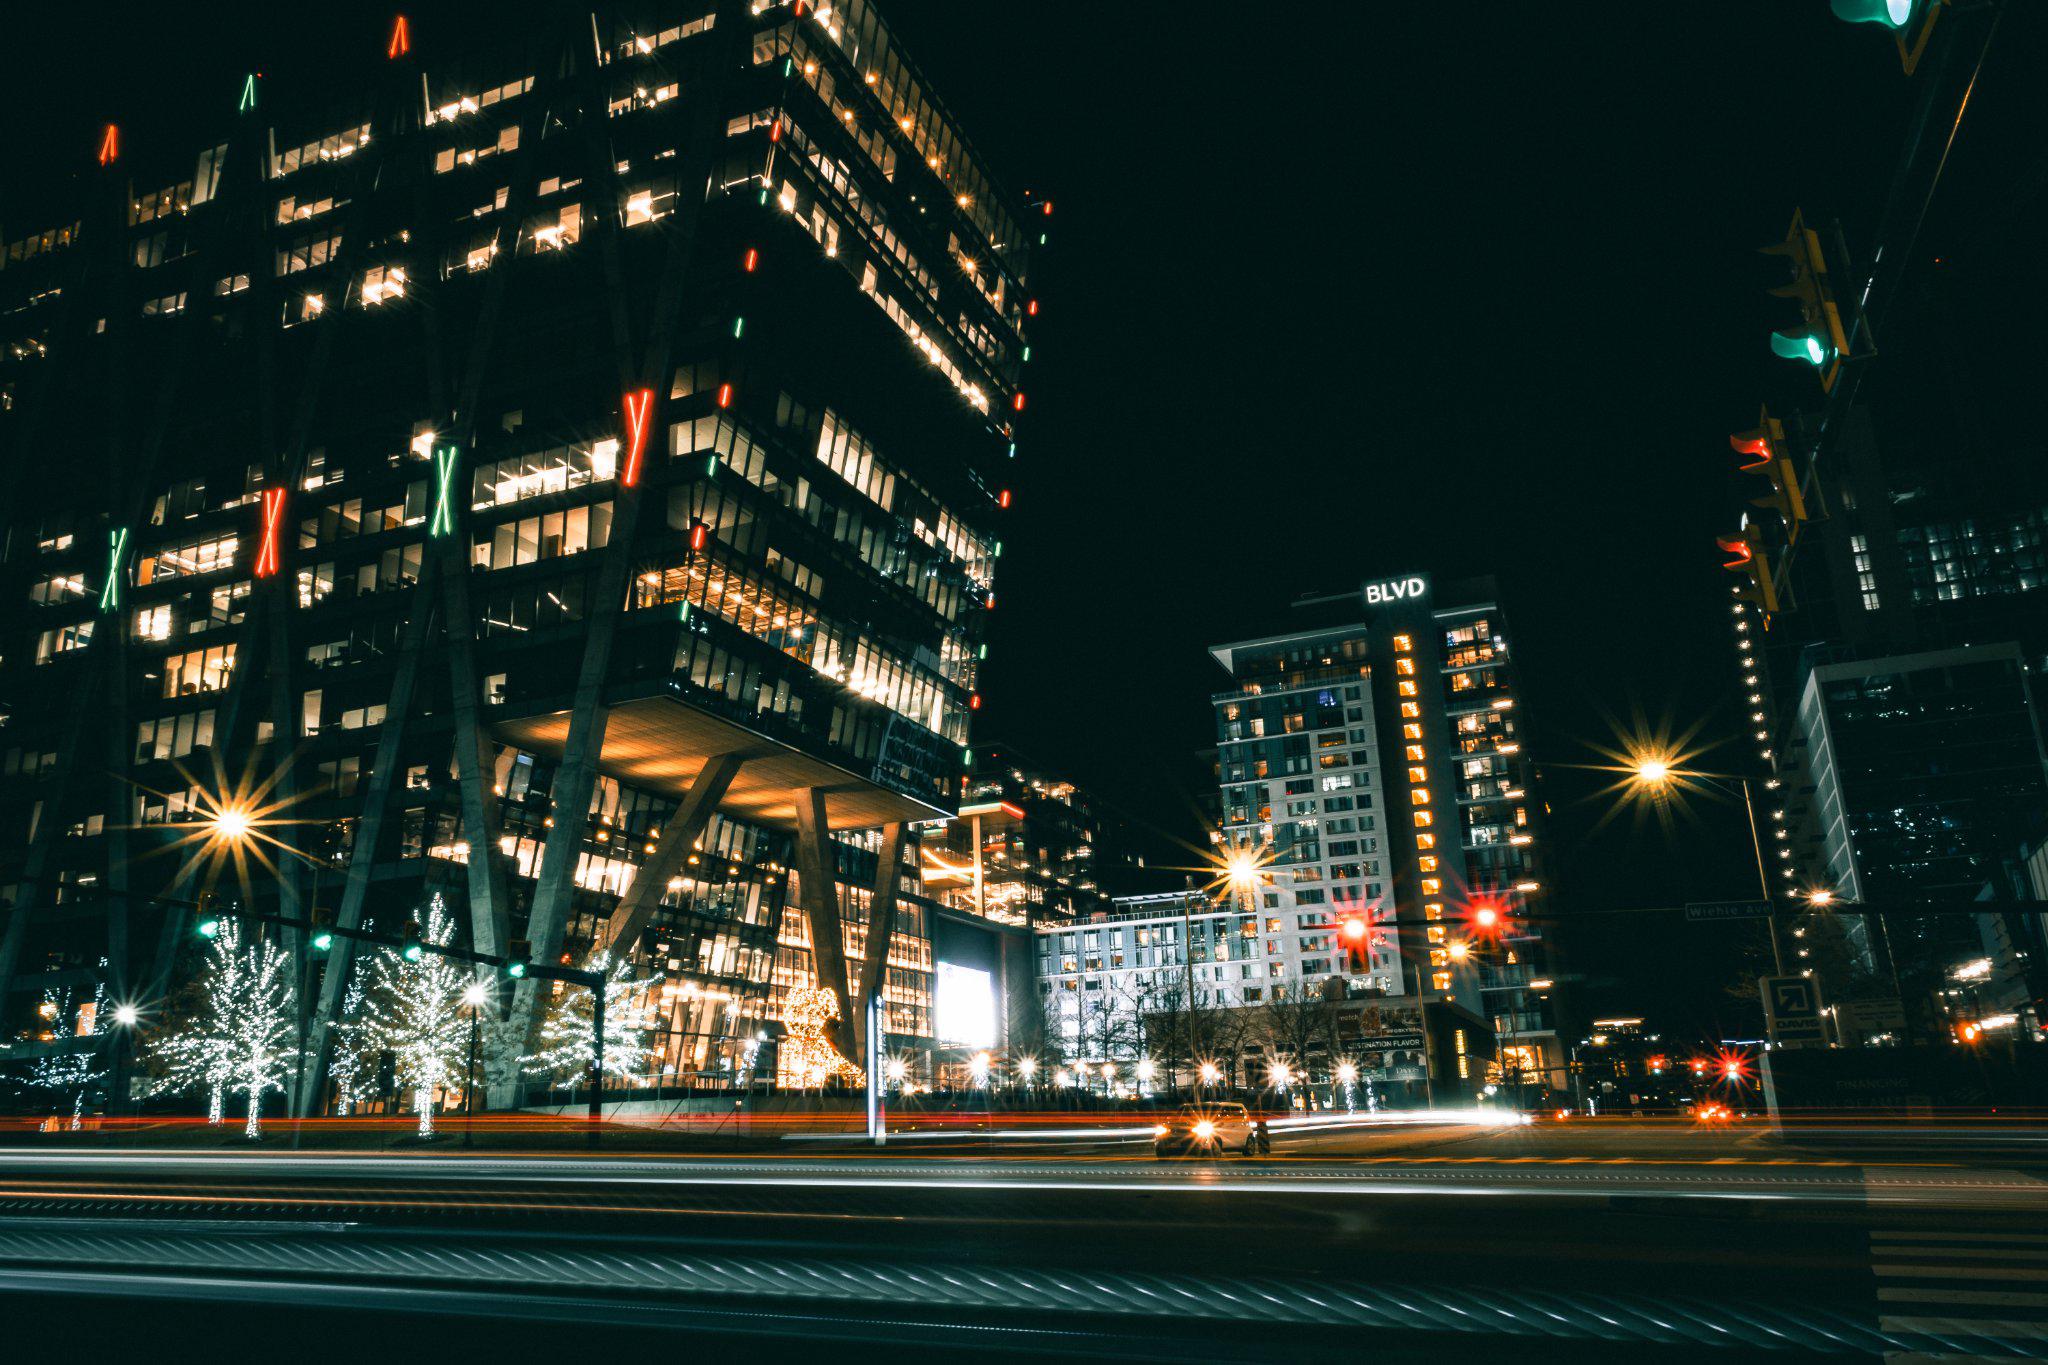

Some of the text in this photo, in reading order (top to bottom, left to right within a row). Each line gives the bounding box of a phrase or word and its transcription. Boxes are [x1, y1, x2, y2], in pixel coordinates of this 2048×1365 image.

[1366, 577, 1425, 604] BLVD
[1689, 904, 1738, 917] Wiehle
[1776, 1019, 1820, 1029] DAVIS
[1392, 1039, 1420, 1048] FLAVOR
